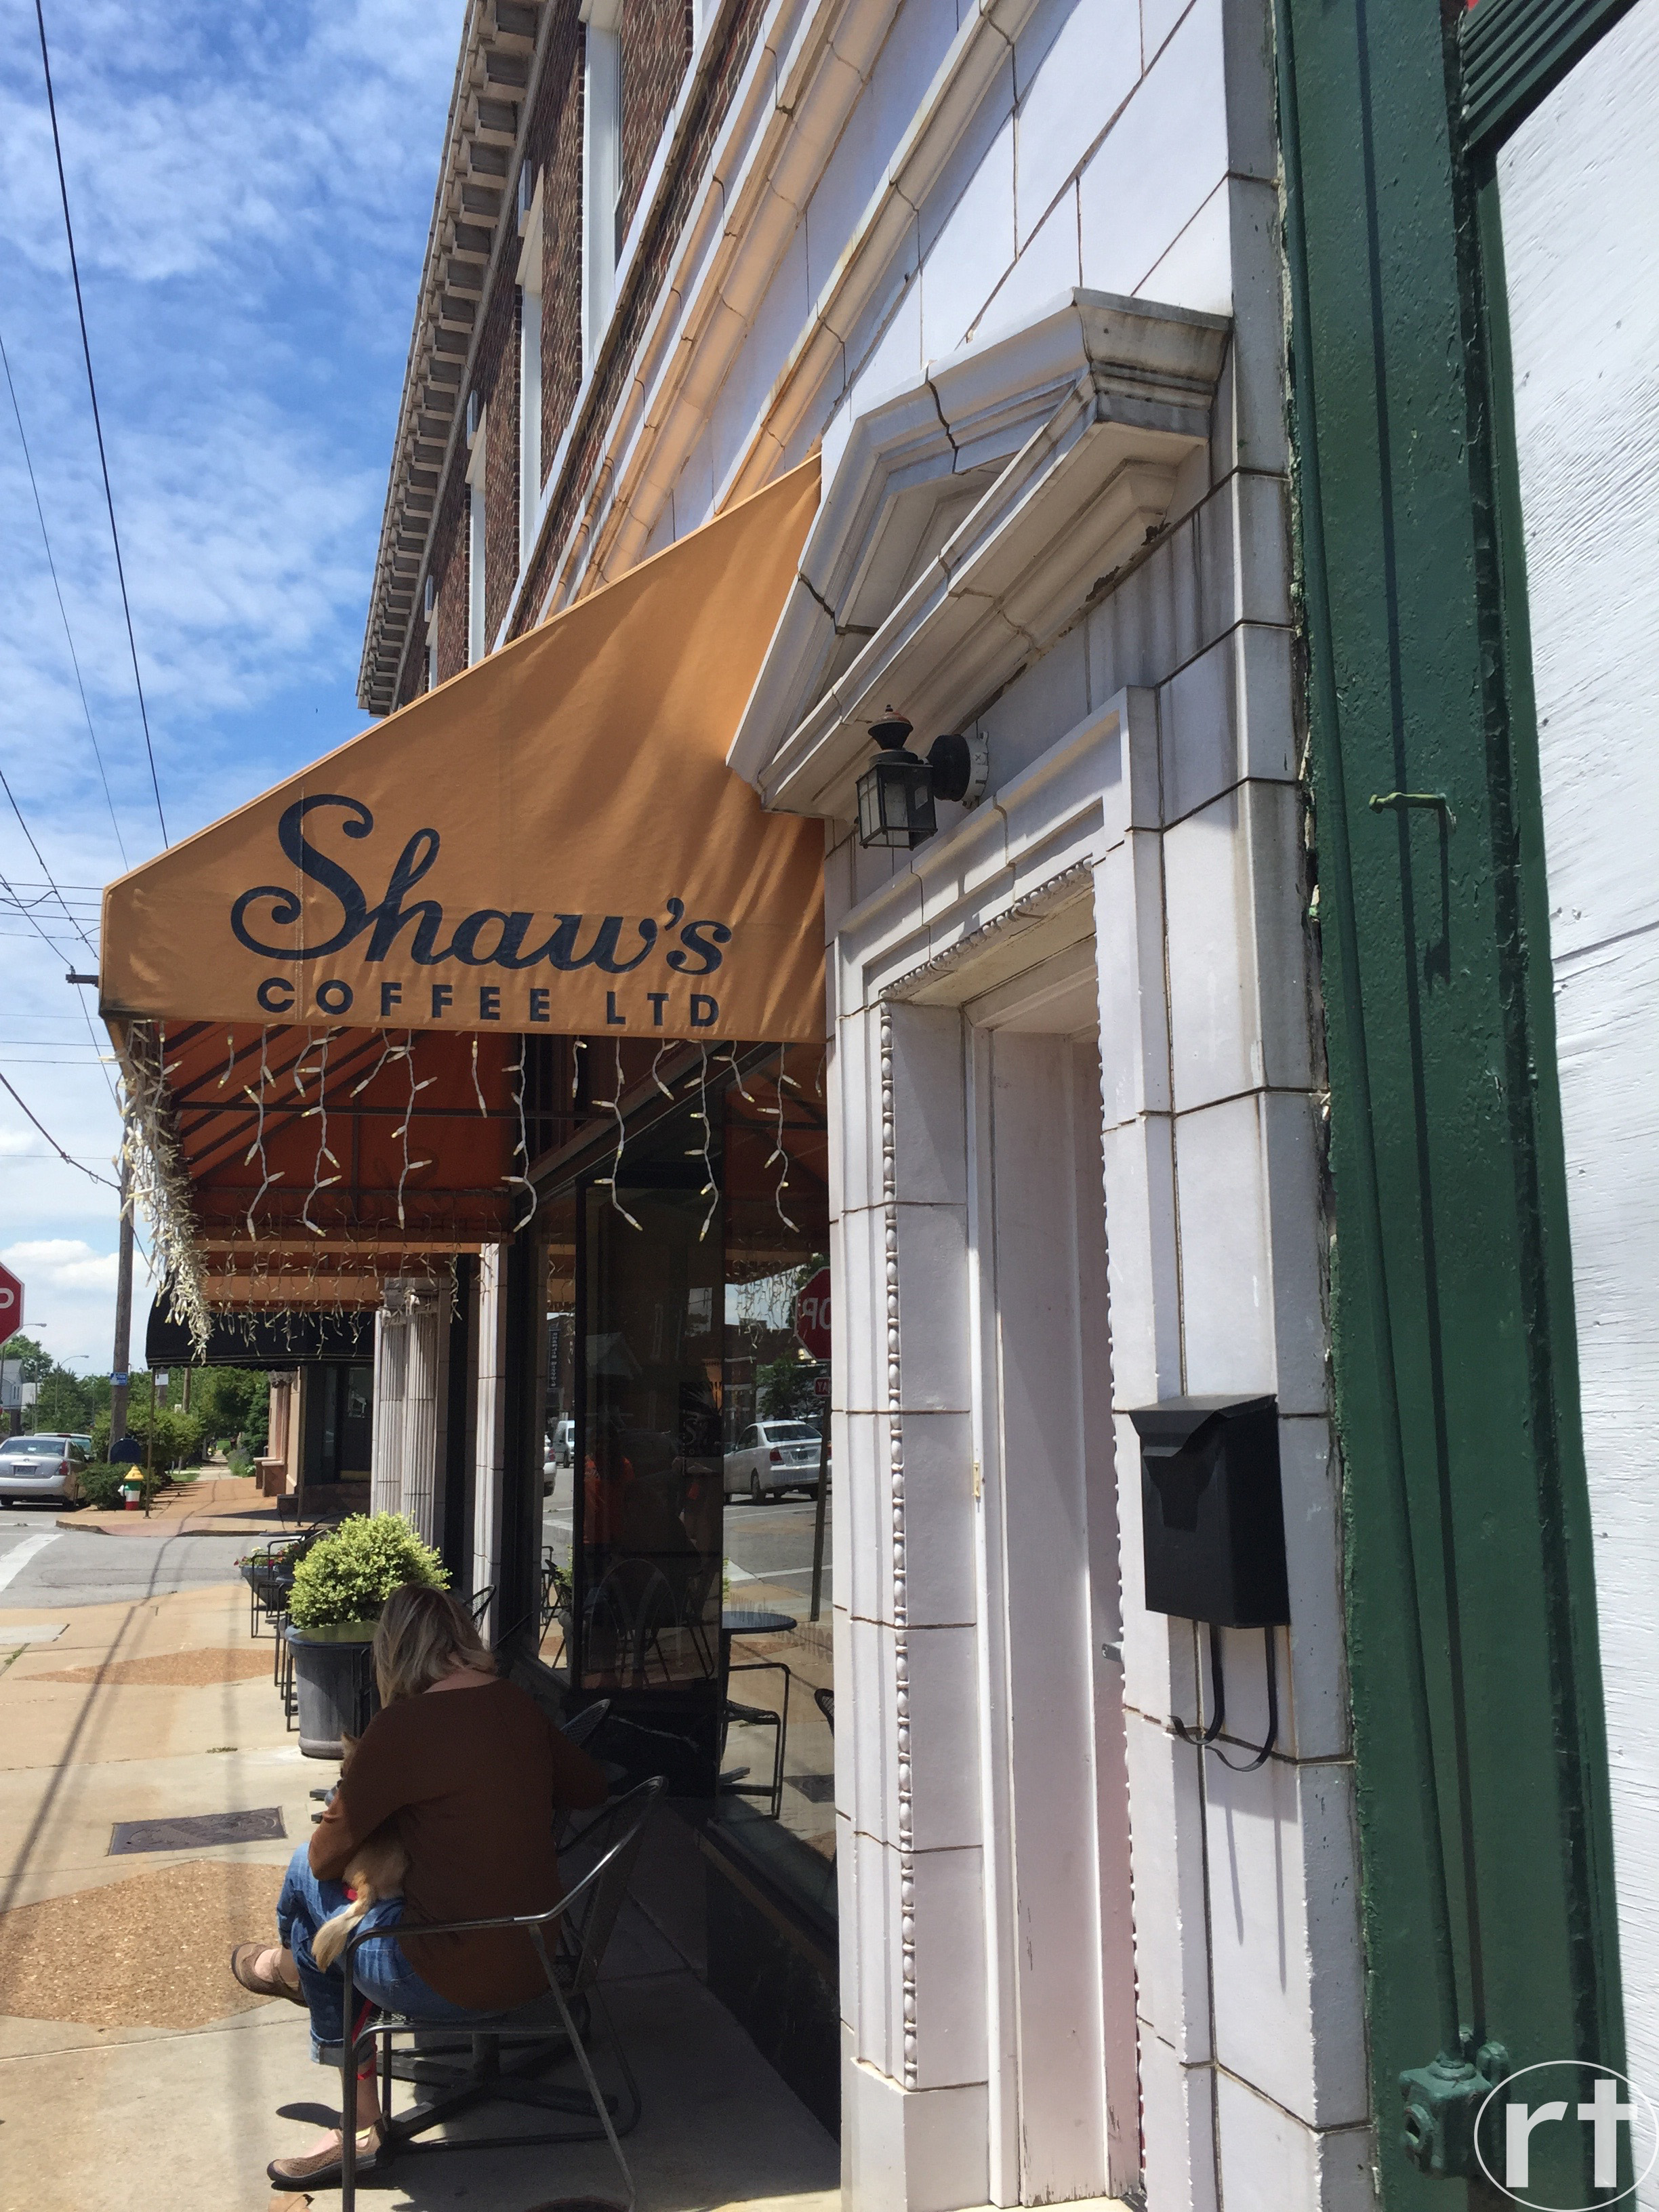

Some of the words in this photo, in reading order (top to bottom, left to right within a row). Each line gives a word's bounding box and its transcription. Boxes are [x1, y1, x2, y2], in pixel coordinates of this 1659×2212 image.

[230, 794, 732, 976] Shaw's
[257, 977, 550, 1022] COFFEE
[607, 991, 720, 1027] LTD
